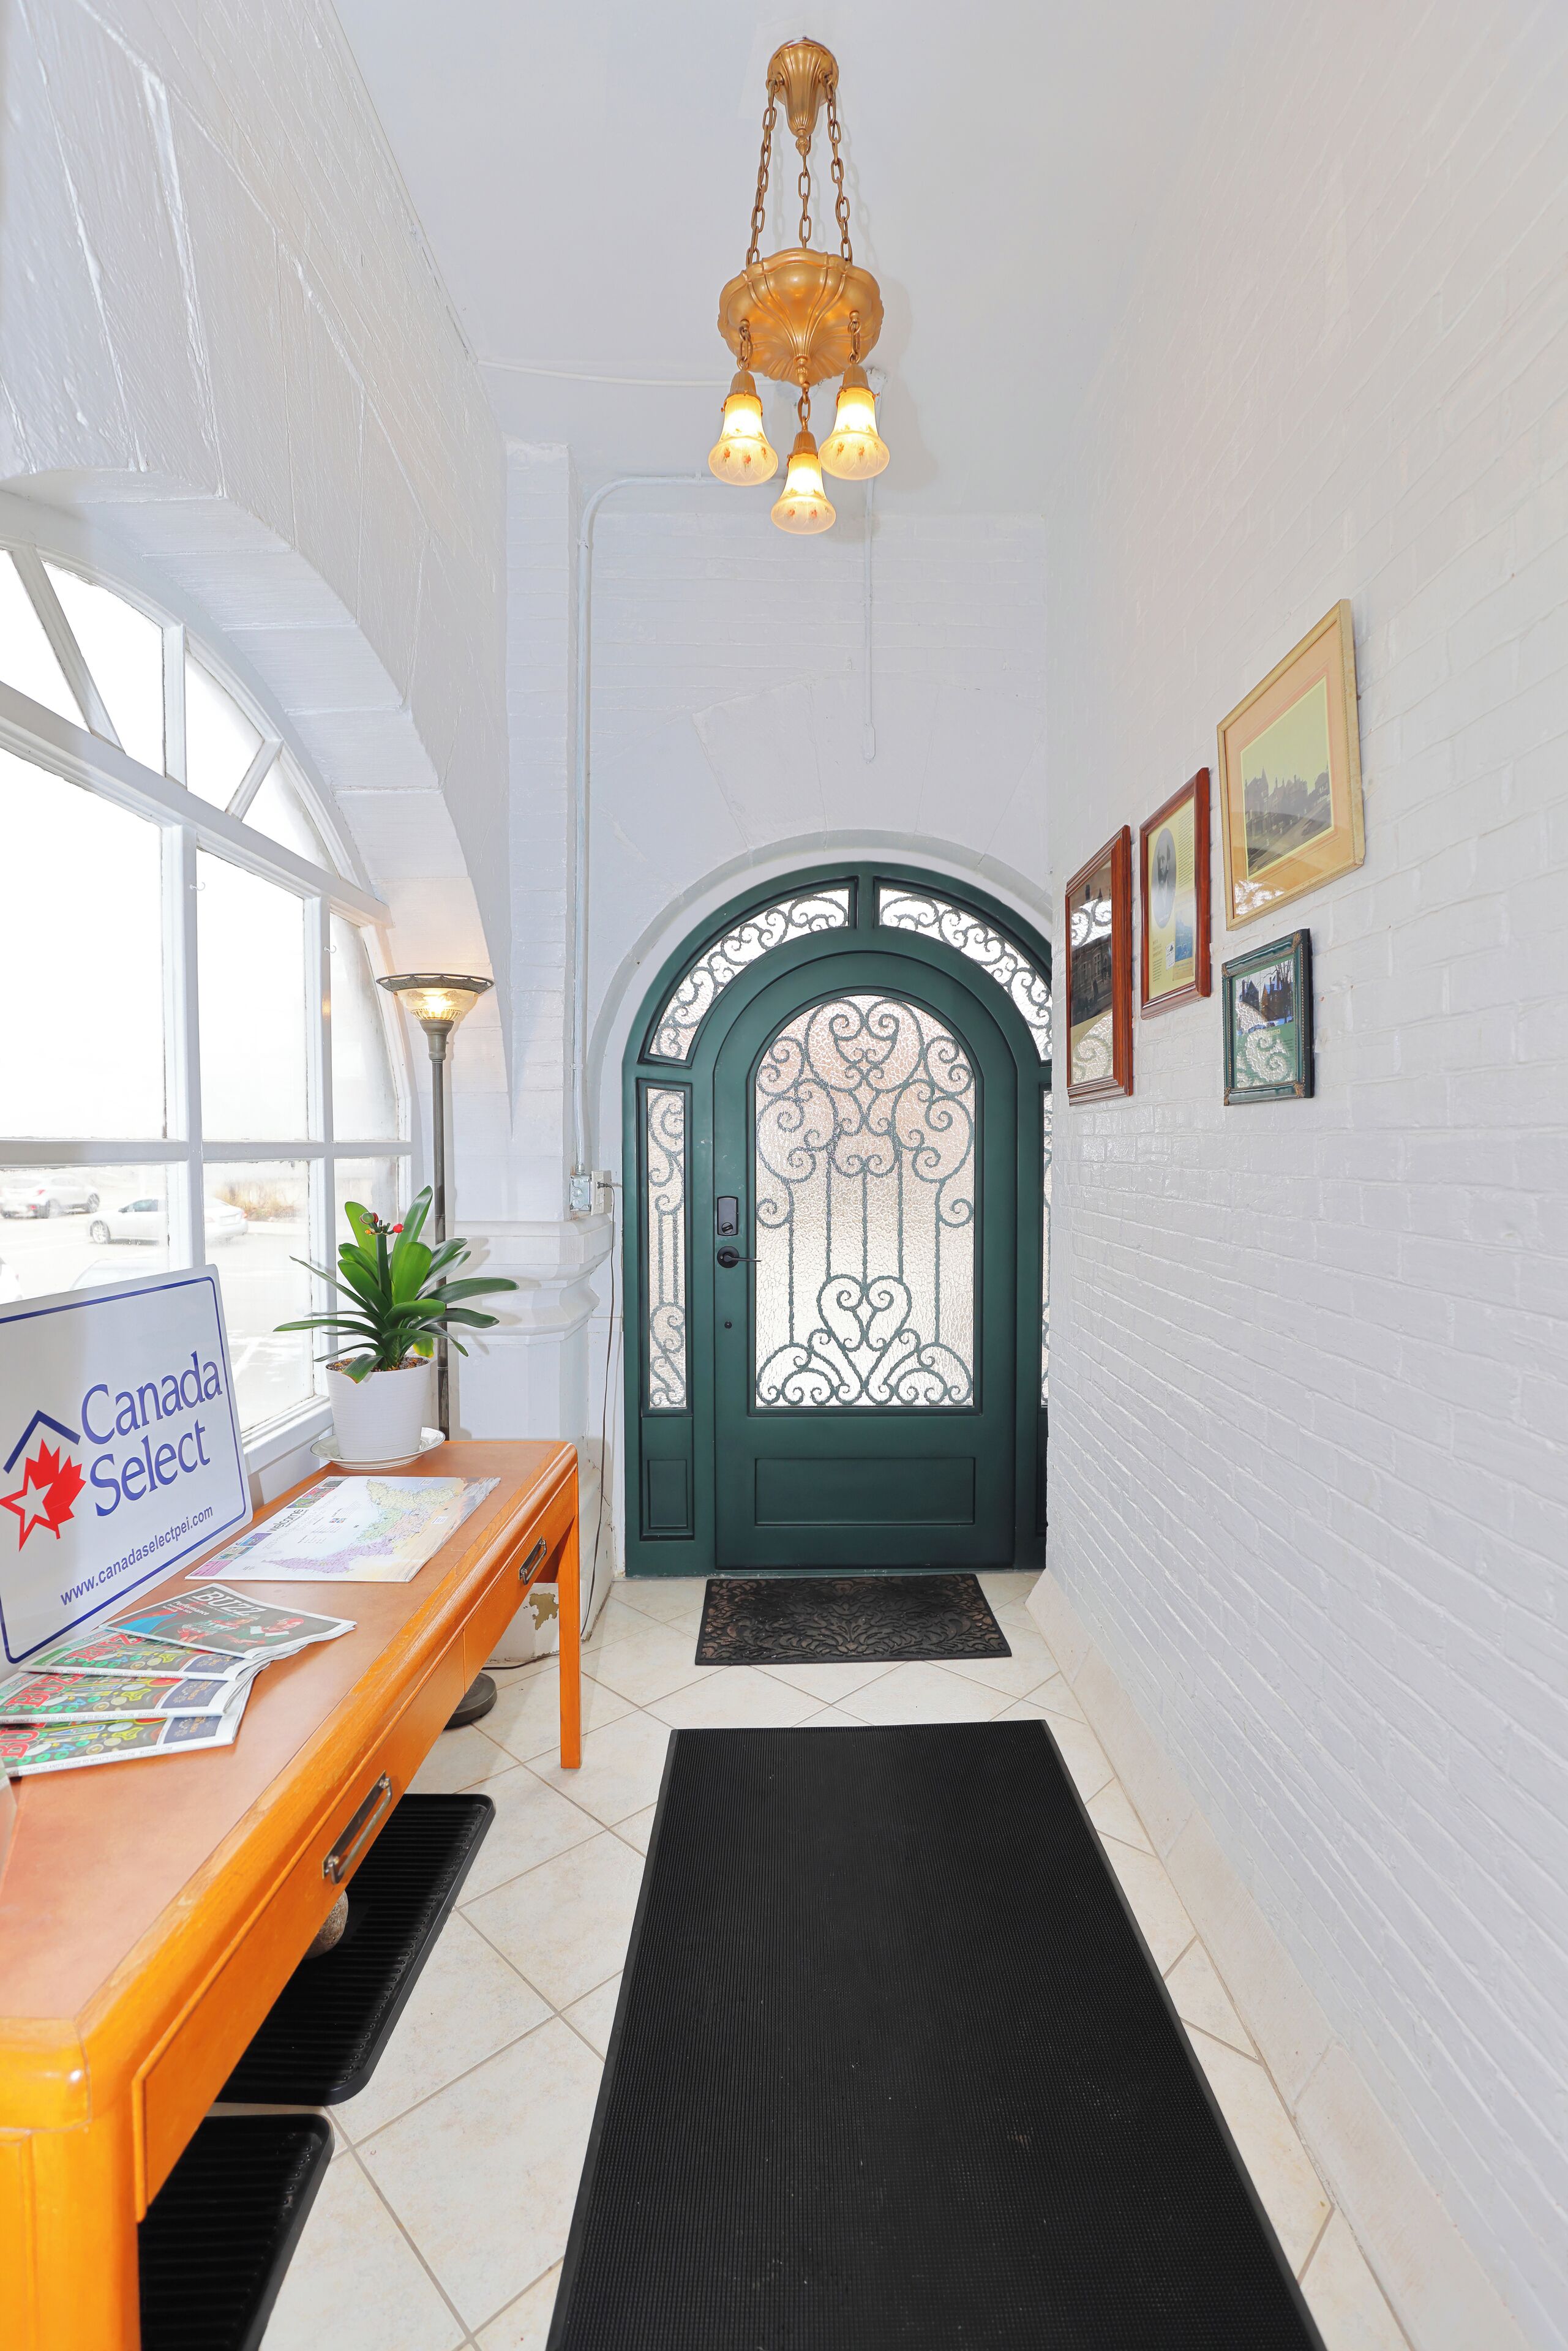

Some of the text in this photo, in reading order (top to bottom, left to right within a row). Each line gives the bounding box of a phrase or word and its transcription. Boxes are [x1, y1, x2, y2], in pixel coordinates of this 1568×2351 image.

[81, 1351, 223, 1444] Canada
[90, 1419, 211, 1517] Select
[266, 1509, 304, 1532] welcome
[60, 1506, 213, 1605] www.canadaselectpei.com
[173, 1600, 209, 1616] Performance
[192, 1591, 268, 1617] BUZZ
[64, 1633, 147, 1662] BUZ
[4, 1673, 80, 1708] BUZ
[140, 1747, 173, 1755] BUZZPEI.COM
